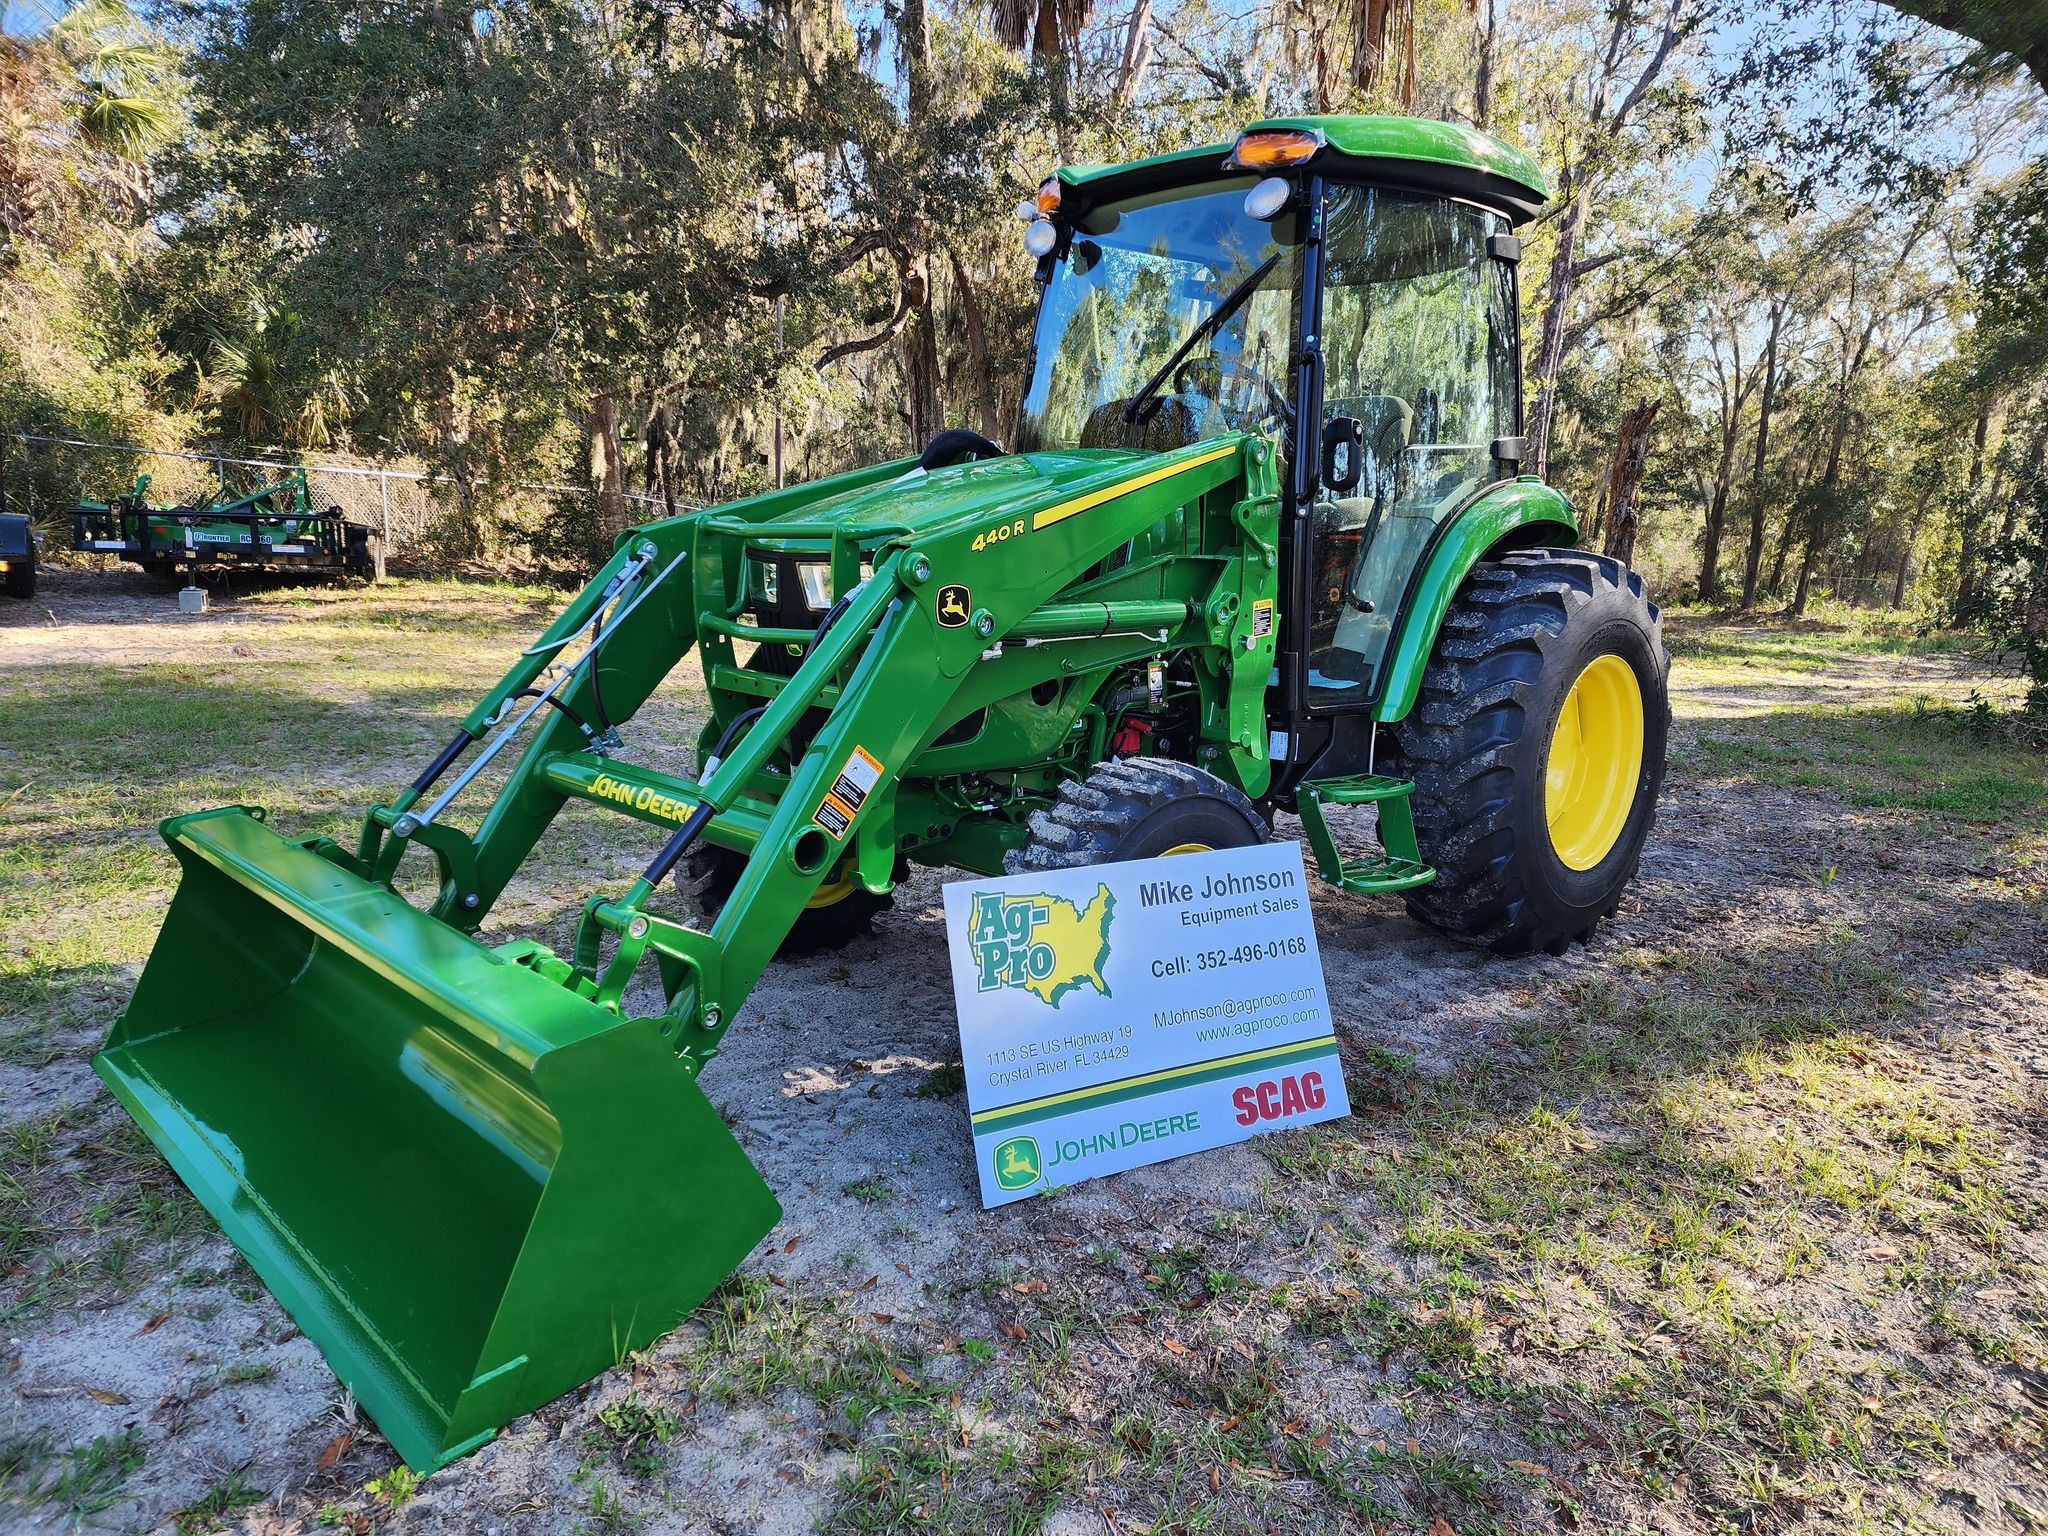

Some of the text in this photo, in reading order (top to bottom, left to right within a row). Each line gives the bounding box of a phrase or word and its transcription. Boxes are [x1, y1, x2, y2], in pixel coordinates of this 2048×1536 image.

[971, 519, 1025, 553] 440 R
[587, 774, 637, 806] JOHN
[1139, 870, 1295, 908] Mike Johnson
[974, 893, 1049, 948] Ag-
[1180, 897, 1299, 927] Equipment Sales
[978, 940, 1057, 993] Pro
[1151, 936, 1307, 979] Cell: 352-496-0168
[987, 1024, 1133, 1066] 1113 SE US Highway 19
[1196, 1007, 1321, 1043] www.agproco.com
[989, 1045, 1130, 1088] Crystal River, FL 34429
[1232, 1071, 1327, 1127] SCAG
[1048, 1110, 1201, 1167] JOHN DEERE
